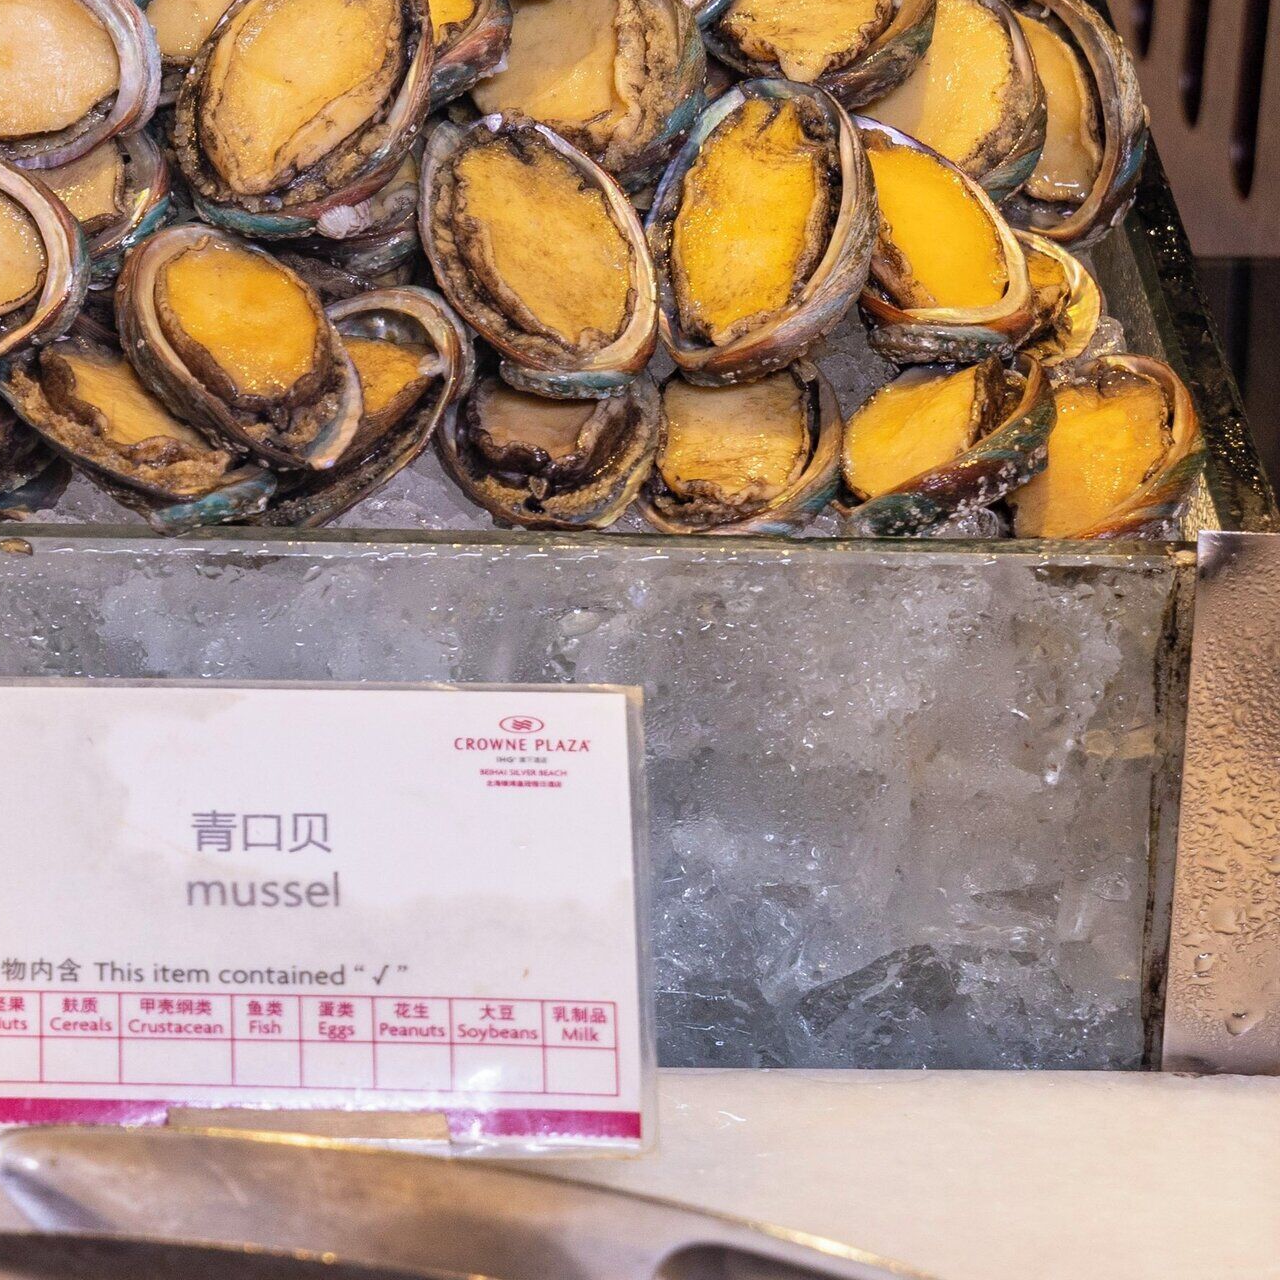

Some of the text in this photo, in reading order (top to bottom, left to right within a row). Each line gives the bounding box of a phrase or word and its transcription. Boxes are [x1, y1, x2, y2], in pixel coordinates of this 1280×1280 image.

[454, 738, 590, 752] CROWNE PLAZA
[191, 810, 332, 853] 青口贝
[187, 871, 340, 908] mussel
[94, 961, 144, 983] This
[154, 964, 210, 983] item
[218, 964, 346, 986] contained
[140, 998, 211, 1015] 甲壳纲类
[248, 1001, 282, 1016] 鱼类
[319, 1001, 353, 1017] 蛋类
[394, 1002, 429, 1019] 花生
[480, 1005, 514, 1021] 大豆
[553, 1006, 607, 1024] 乳制品
[50, 1017, 113, 1032] Cereals
[127, 1019, 224, 1037] Crustacean
[249, 1020, 281, 1034] Fish
[317, 1021, 356, 1042] Eggs
[379, 1022, 446, 1037] Peanuts
[458, 1024, 539, 1042] Soybeans
[562, 1027, 598, 1041] Milk
